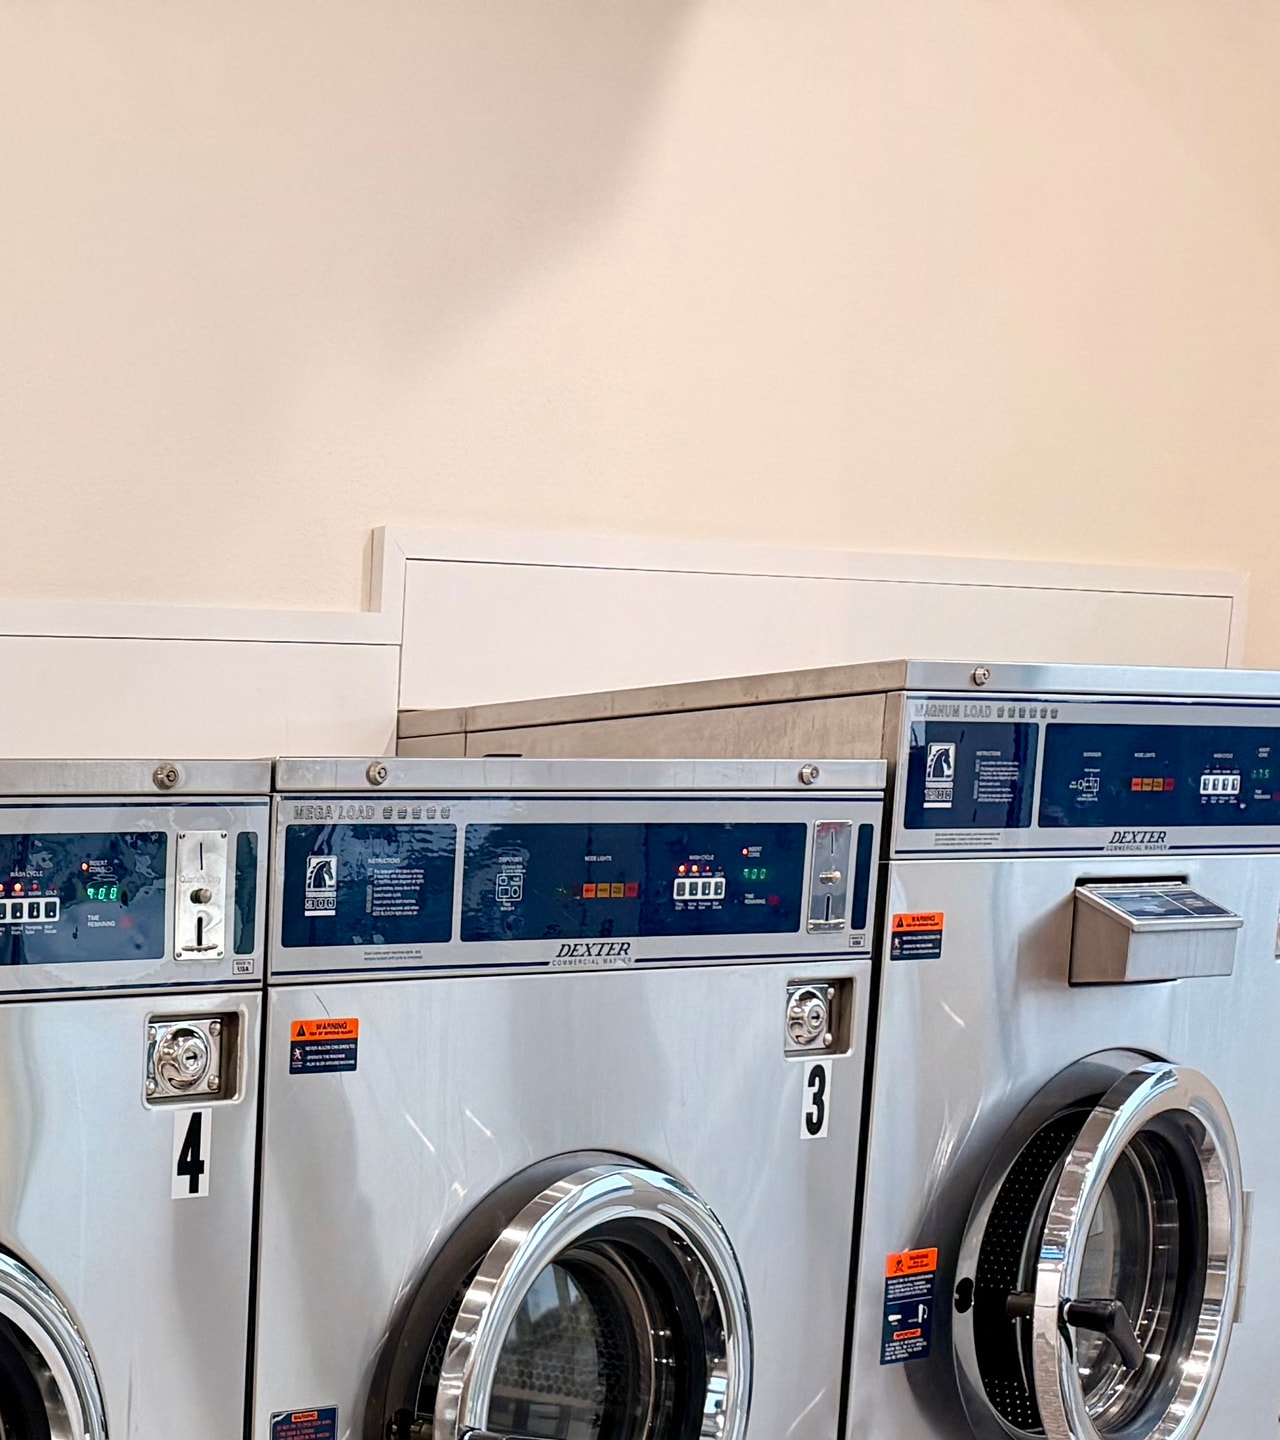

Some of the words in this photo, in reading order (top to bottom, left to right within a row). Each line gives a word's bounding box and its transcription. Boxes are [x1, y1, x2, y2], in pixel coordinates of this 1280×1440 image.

[964, 705, 991, 718] LOAD
[294, 805, 333, 819] MEGA
[338, 805, 375, 819] LOAD
[1109, 831, 1167, 844] DEXTER
[556, 942, 630, 957] DEXTER
[806, 1064, 826, 1135] 3
[177, 1112, 205, 1194] 4
